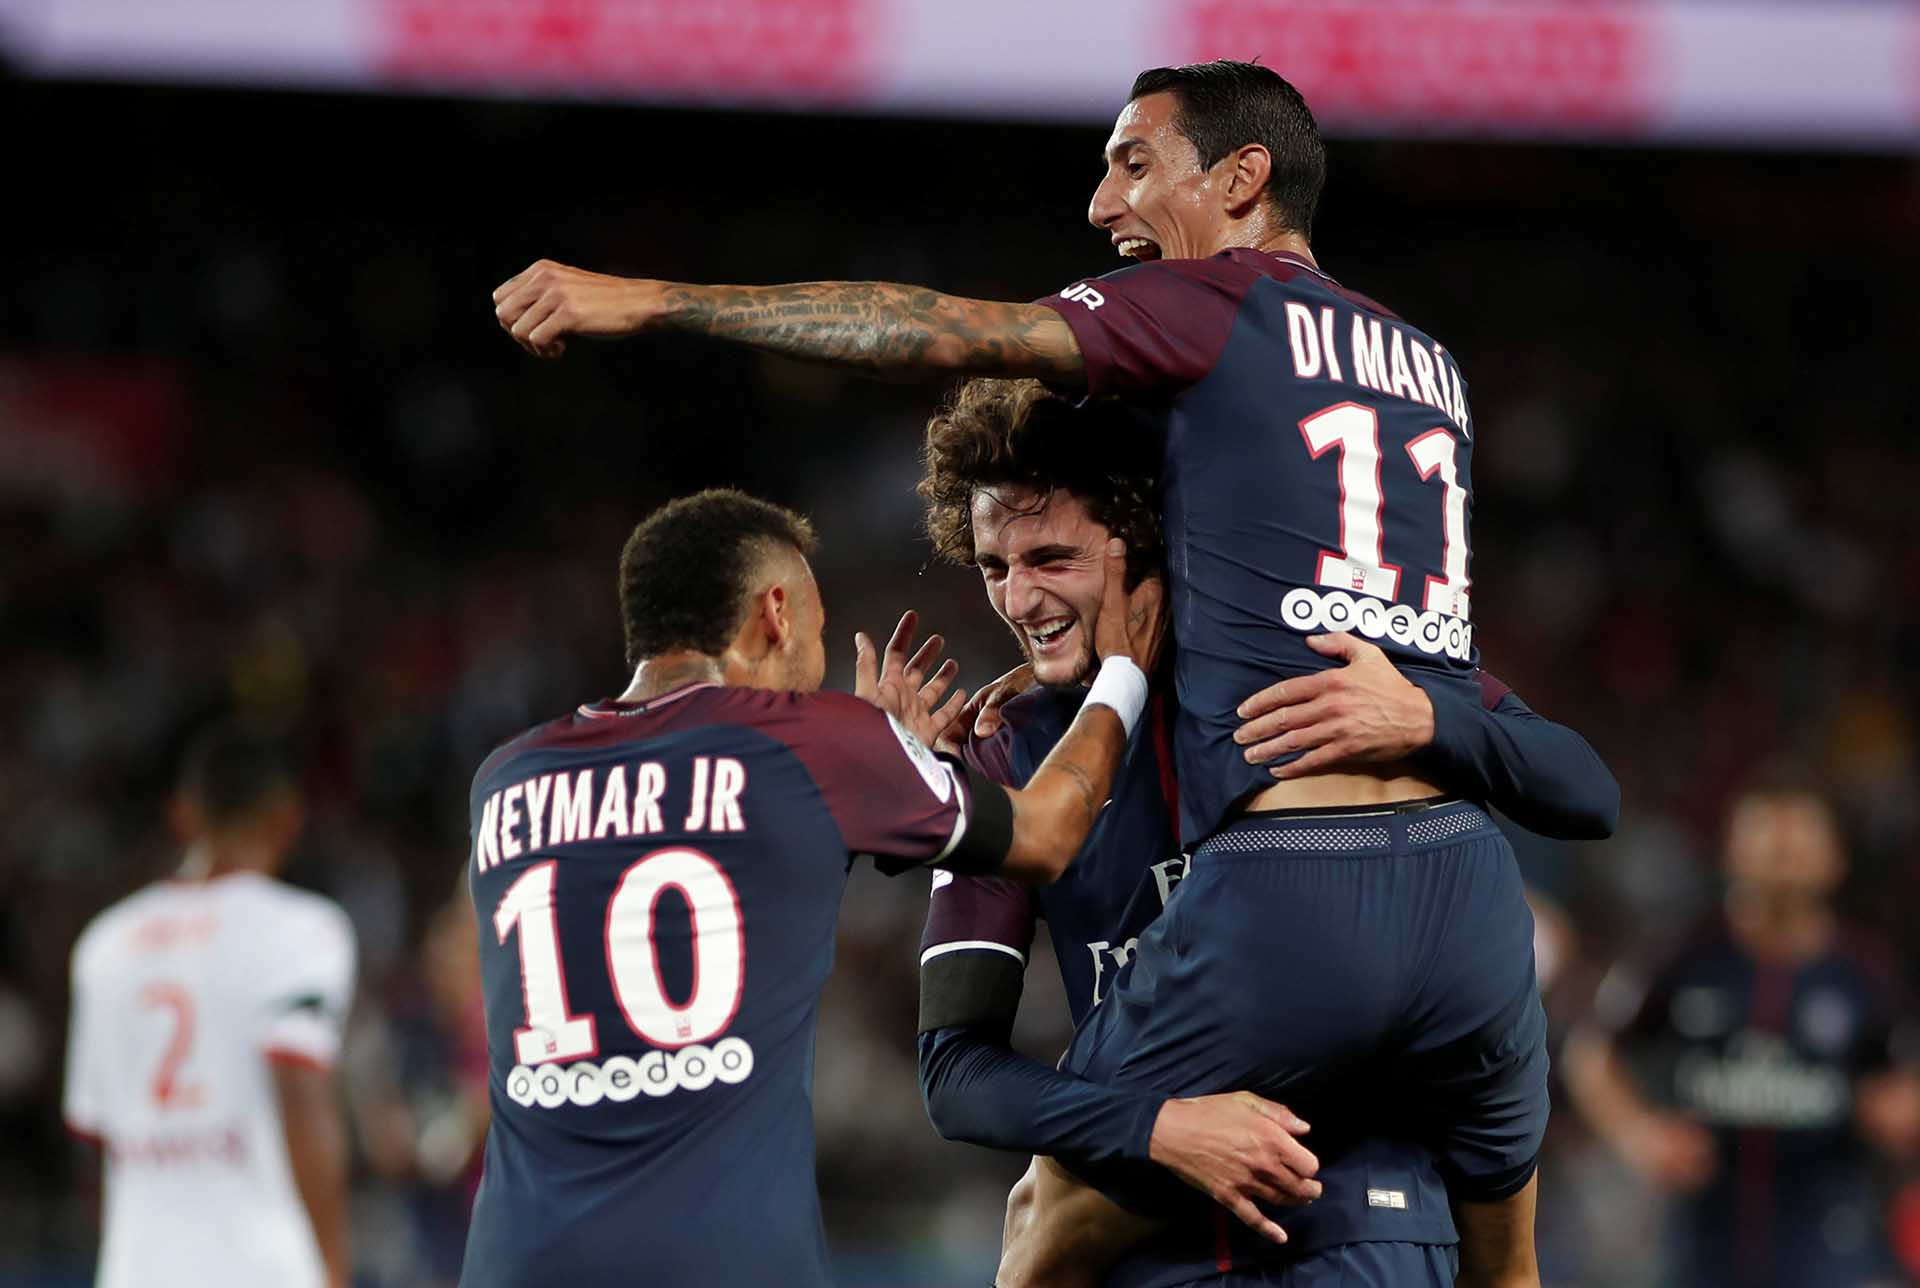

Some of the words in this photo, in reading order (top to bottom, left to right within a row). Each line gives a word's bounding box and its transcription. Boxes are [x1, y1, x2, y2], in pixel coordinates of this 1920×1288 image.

[1284, 301, 1342, 383] DI
[1298, 401, 1471, 621] 11
[475, 760, 667, 874] NEYMAR
[684, 757, 747, 832] JR
[493, 846, 746, 1065] 10
[507, 1037, 754, 1108] ooredoo
